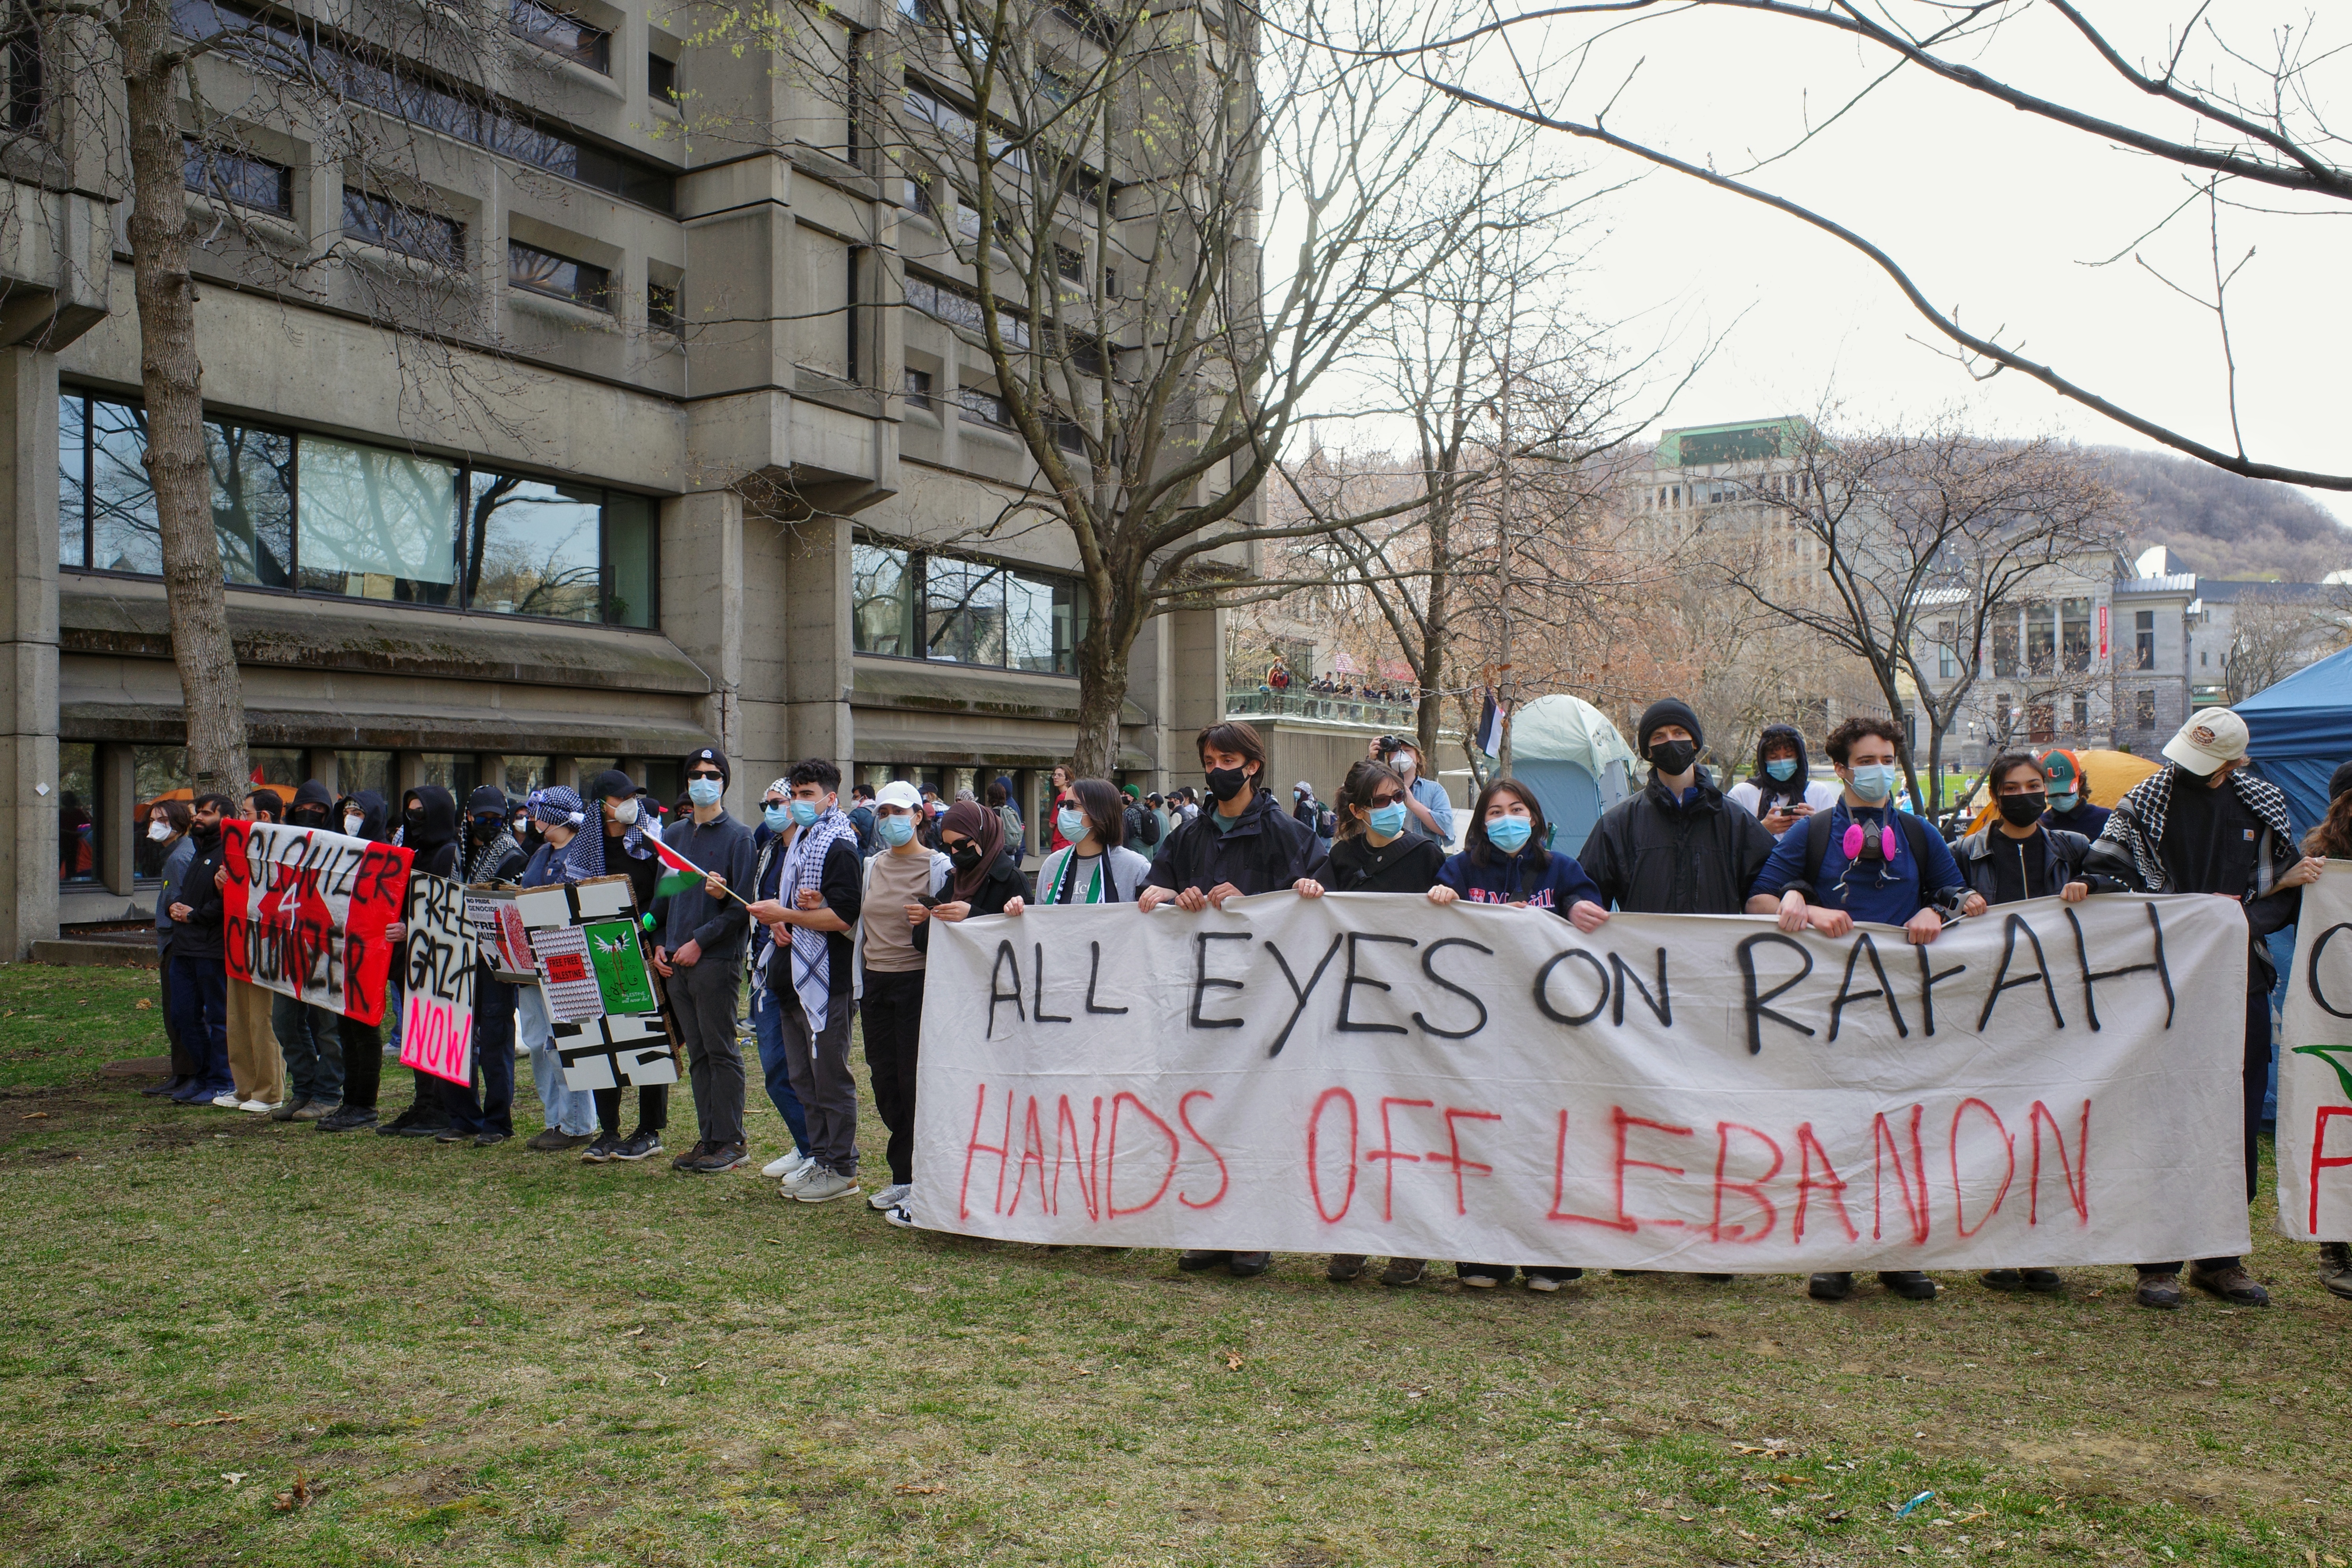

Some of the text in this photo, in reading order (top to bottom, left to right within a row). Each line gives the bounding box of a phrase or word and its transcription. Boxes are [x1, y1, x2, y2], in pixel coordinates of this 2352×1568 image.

[2047, 766, 2065, 778] U
[222, 825, 403, 907] COLONIZER
[278, 882, 301, 931] 4
[410, 873, 475, 941] FREE
[473, 921, 504, 931] FREE
[477, 931, 507, 942] PALESTINE
[226, 915, 370, 1014] COLONIZER
[406, 929, 476, 1006] GAZA
[552, 969, 582, 980] PALESTINE
[563, 956, 579, 966] FREE
[987, 939, 1129, 1039] ALL
[1189, 931, 1494, 1058] EYES
[1532, 946, 1672, 1028] ON
[403, 997, 471, 1077] NOW
[959, 1083, 2092, 1245] HANDS OFF LEBANON
